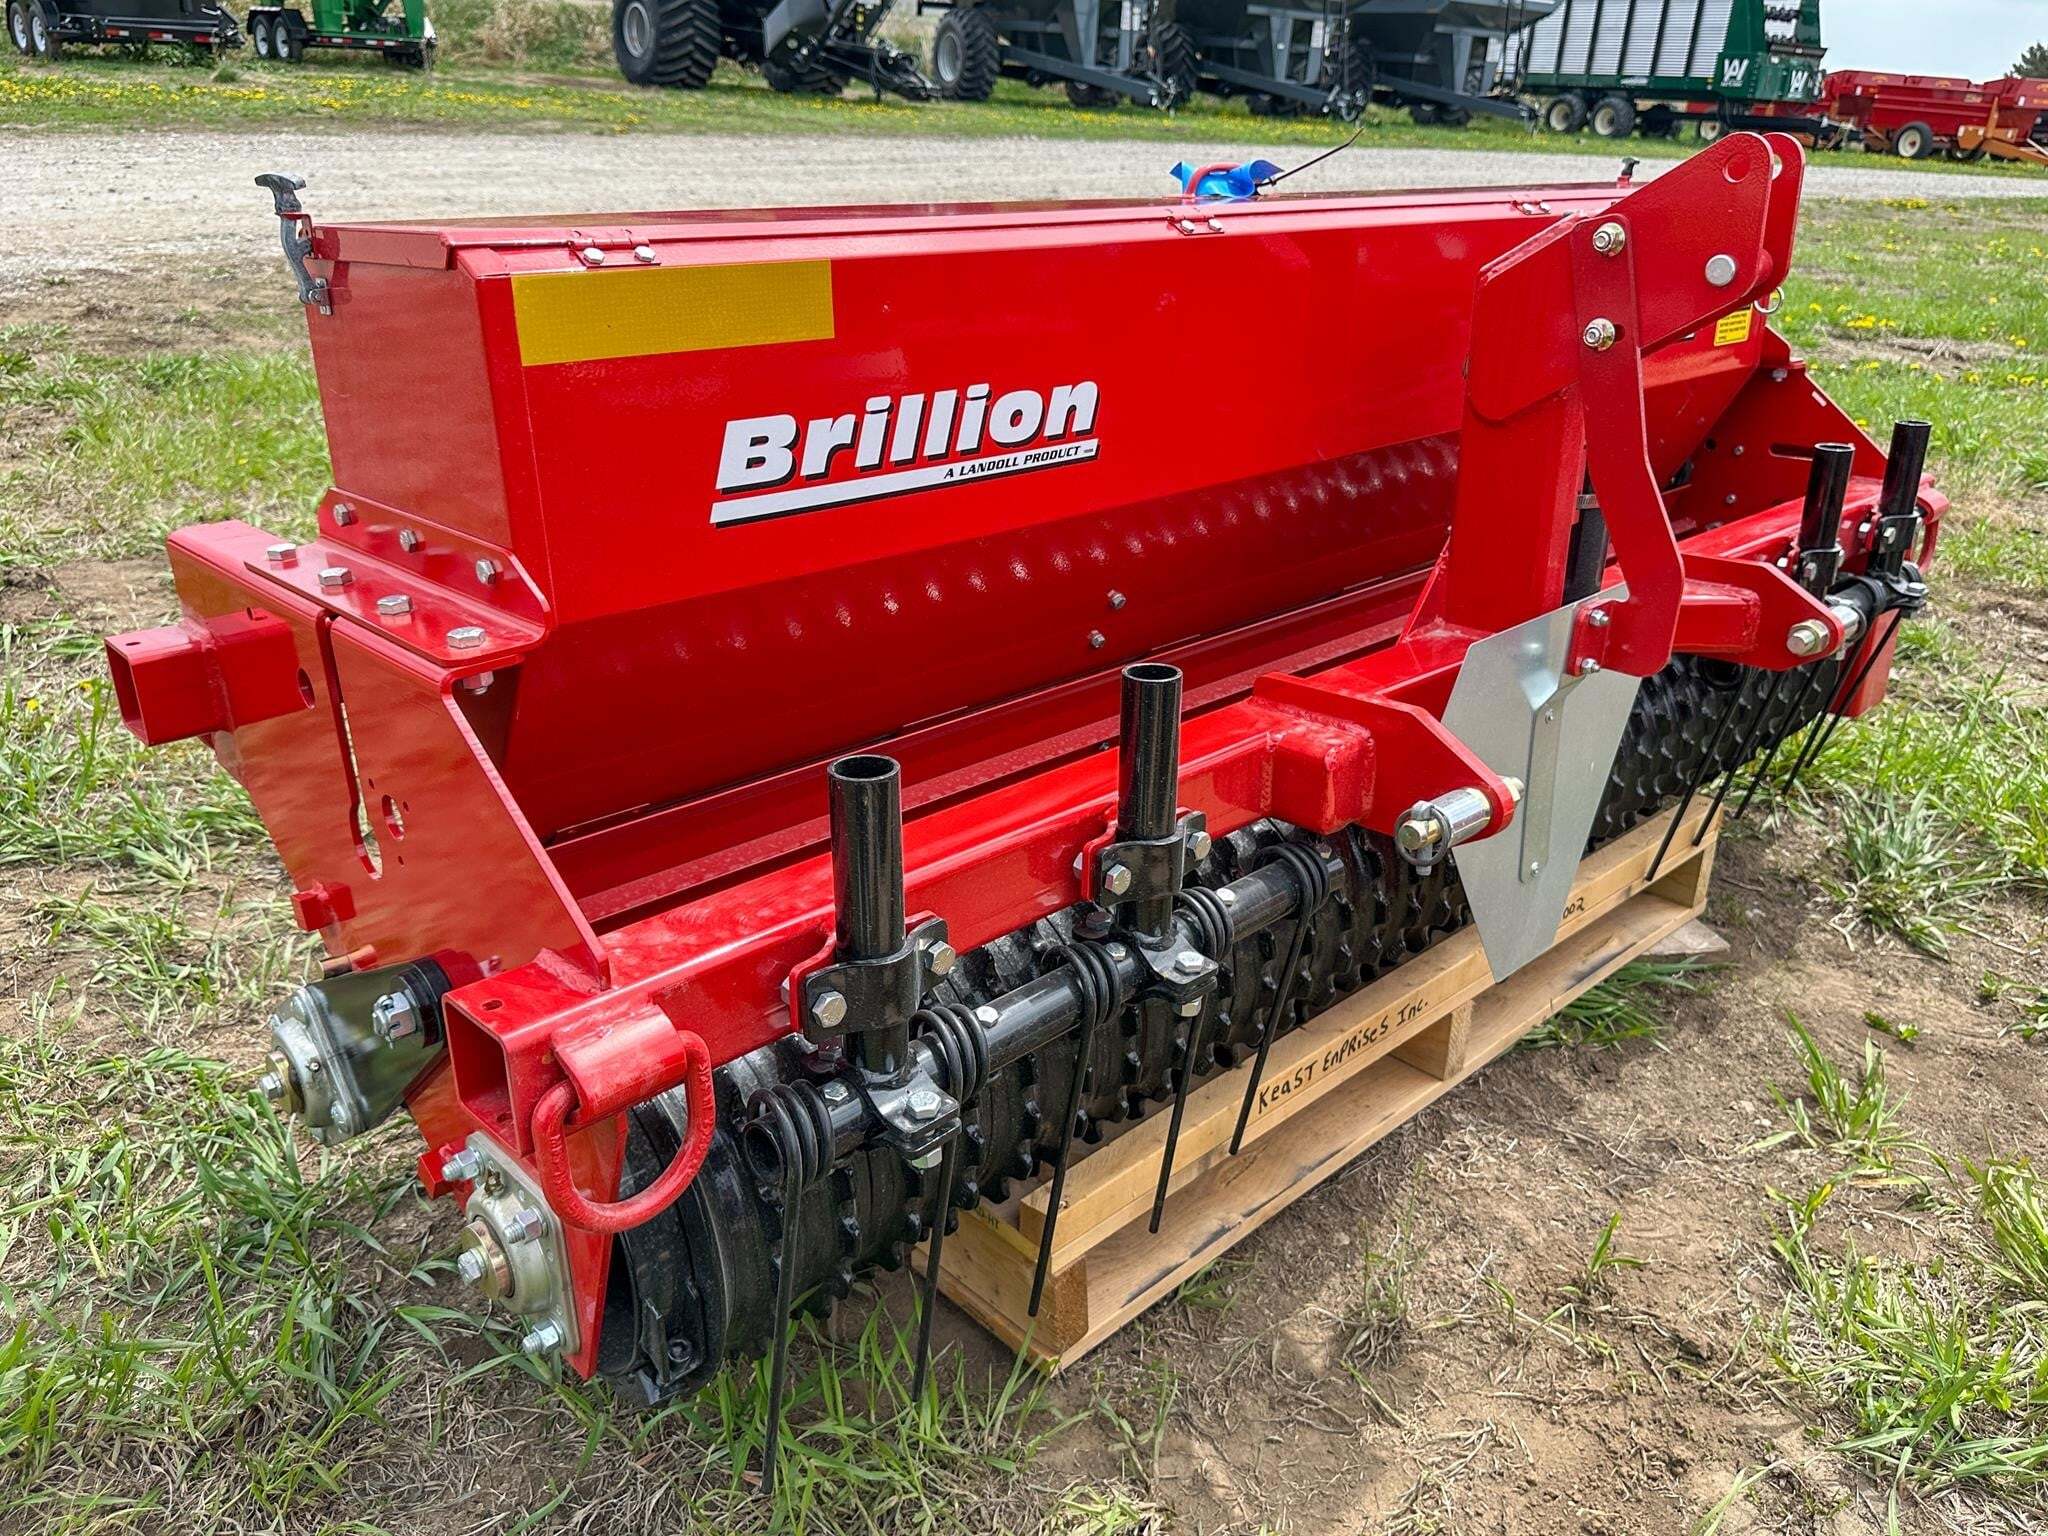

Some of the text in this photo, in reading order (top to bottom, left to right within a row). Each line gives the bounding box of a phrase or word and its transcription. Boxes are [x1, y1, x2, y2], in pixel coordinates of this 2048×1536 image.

[715, 380, 1098, 489] Brillion
[944, 446, 1081, 479] A LANDOLL PRODUCT
[1396, 999, 1429, 1027] Inc.
